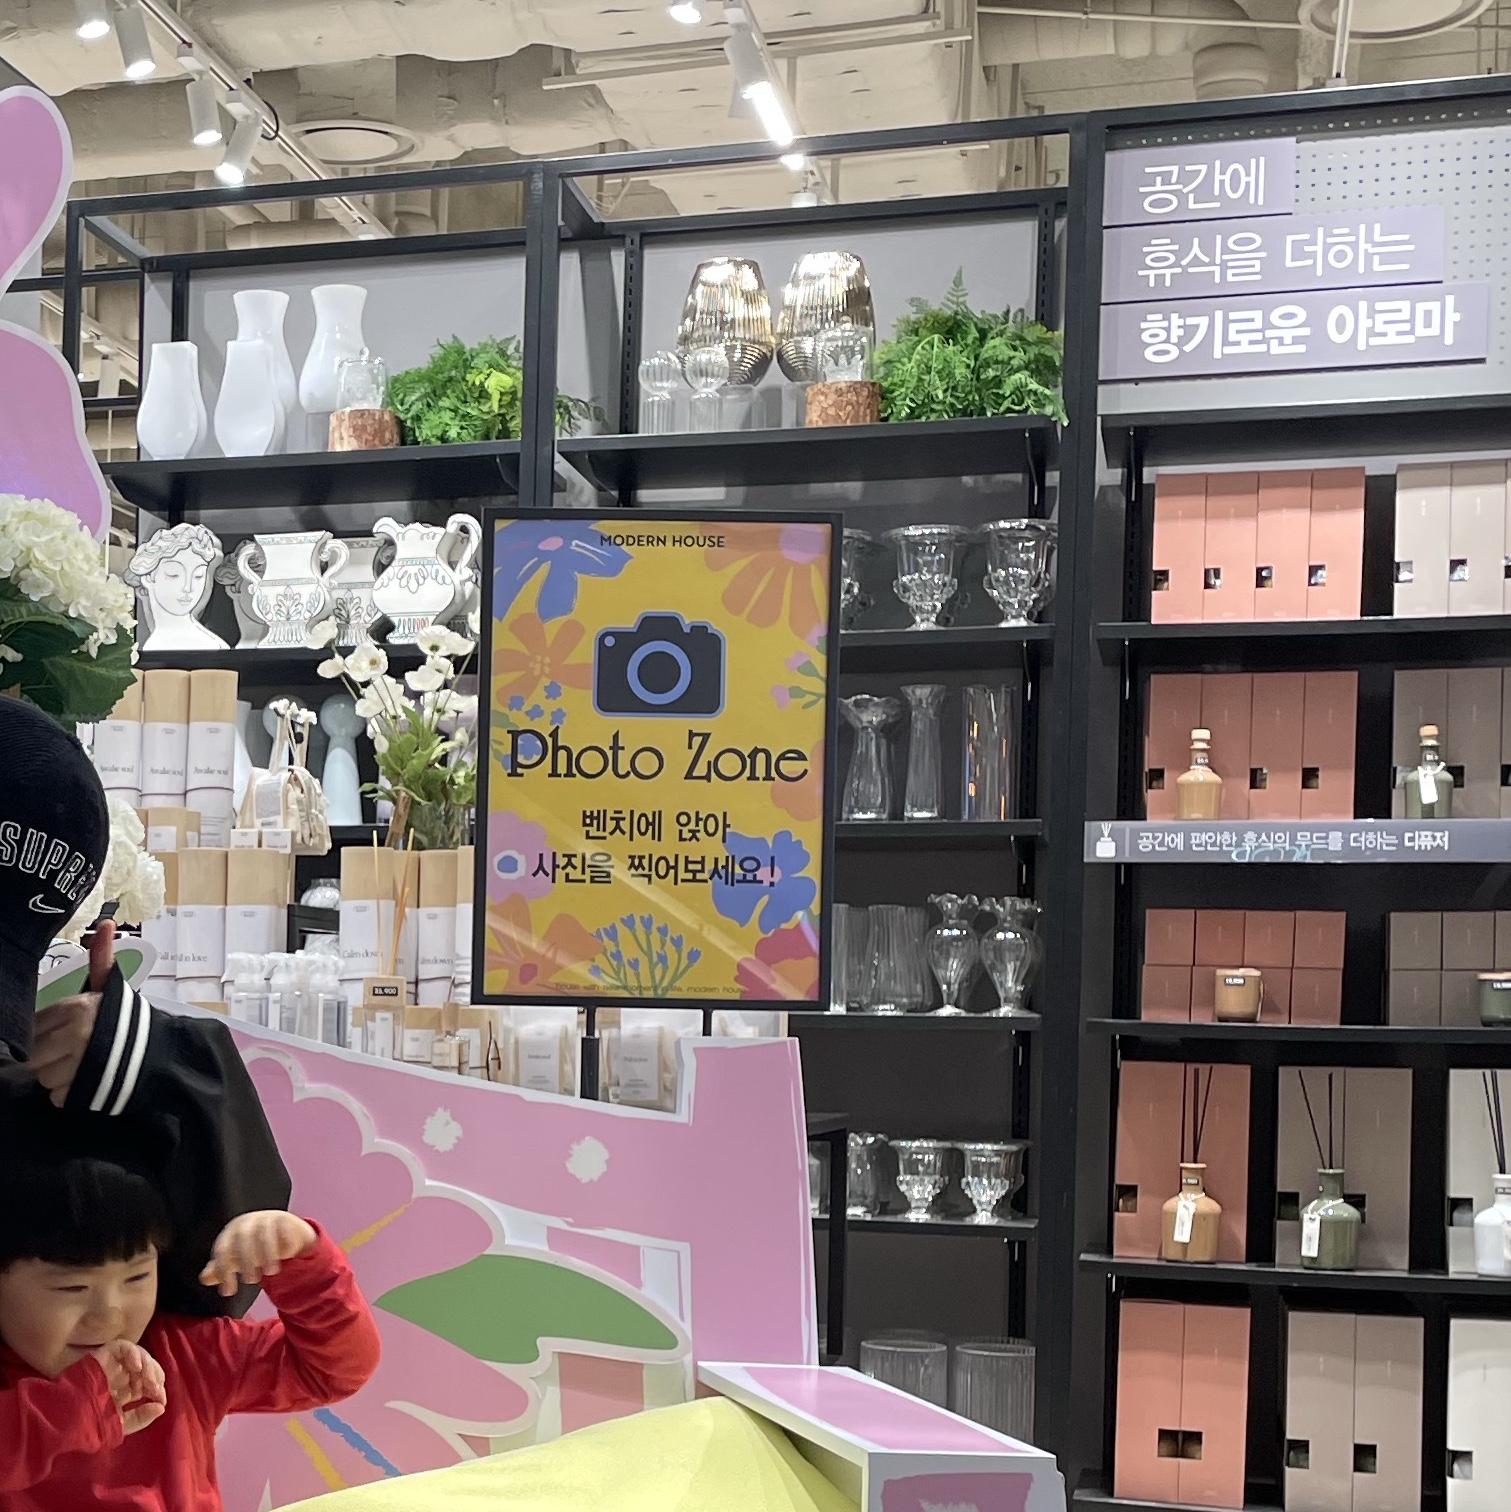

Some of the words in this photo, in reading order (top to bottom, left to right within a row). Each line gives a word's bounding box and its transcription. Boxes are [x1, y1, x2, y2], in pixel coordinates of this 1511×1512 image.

[1139, 156, 1265, 214] 공간에
[1138, 231, 1267, 288] 휴식을
[1285, 222, 1416, 277] 더하는
[1140, 304, 1312, 364] 향기로운
[1327, 295, 1461, 351] 아로마
[600, 534, 667, 548] MODERN
[672, 535, 726, 549] HOUSE
[506, 725, 665, 781] Photo
[683, 729, 809, 783] Zone
[581, 809, 663, 842] 벤치에
[675, 811, 731, 844] 앉아
[1138, 831, 1184, 852] 공간에
[1190, 831, 1238, 851] 편안한
[1241, 831, 1290, 851] 휴식의
[1295, 831, 1344, 851] 무드를
[1350, 830, 1399, 851] 더하는
[1404, 830, 1449, 851] 디퓨저
[531, 852, 614, 885] 사진을
[627, 854, 776, 888] 찍어보세요!
